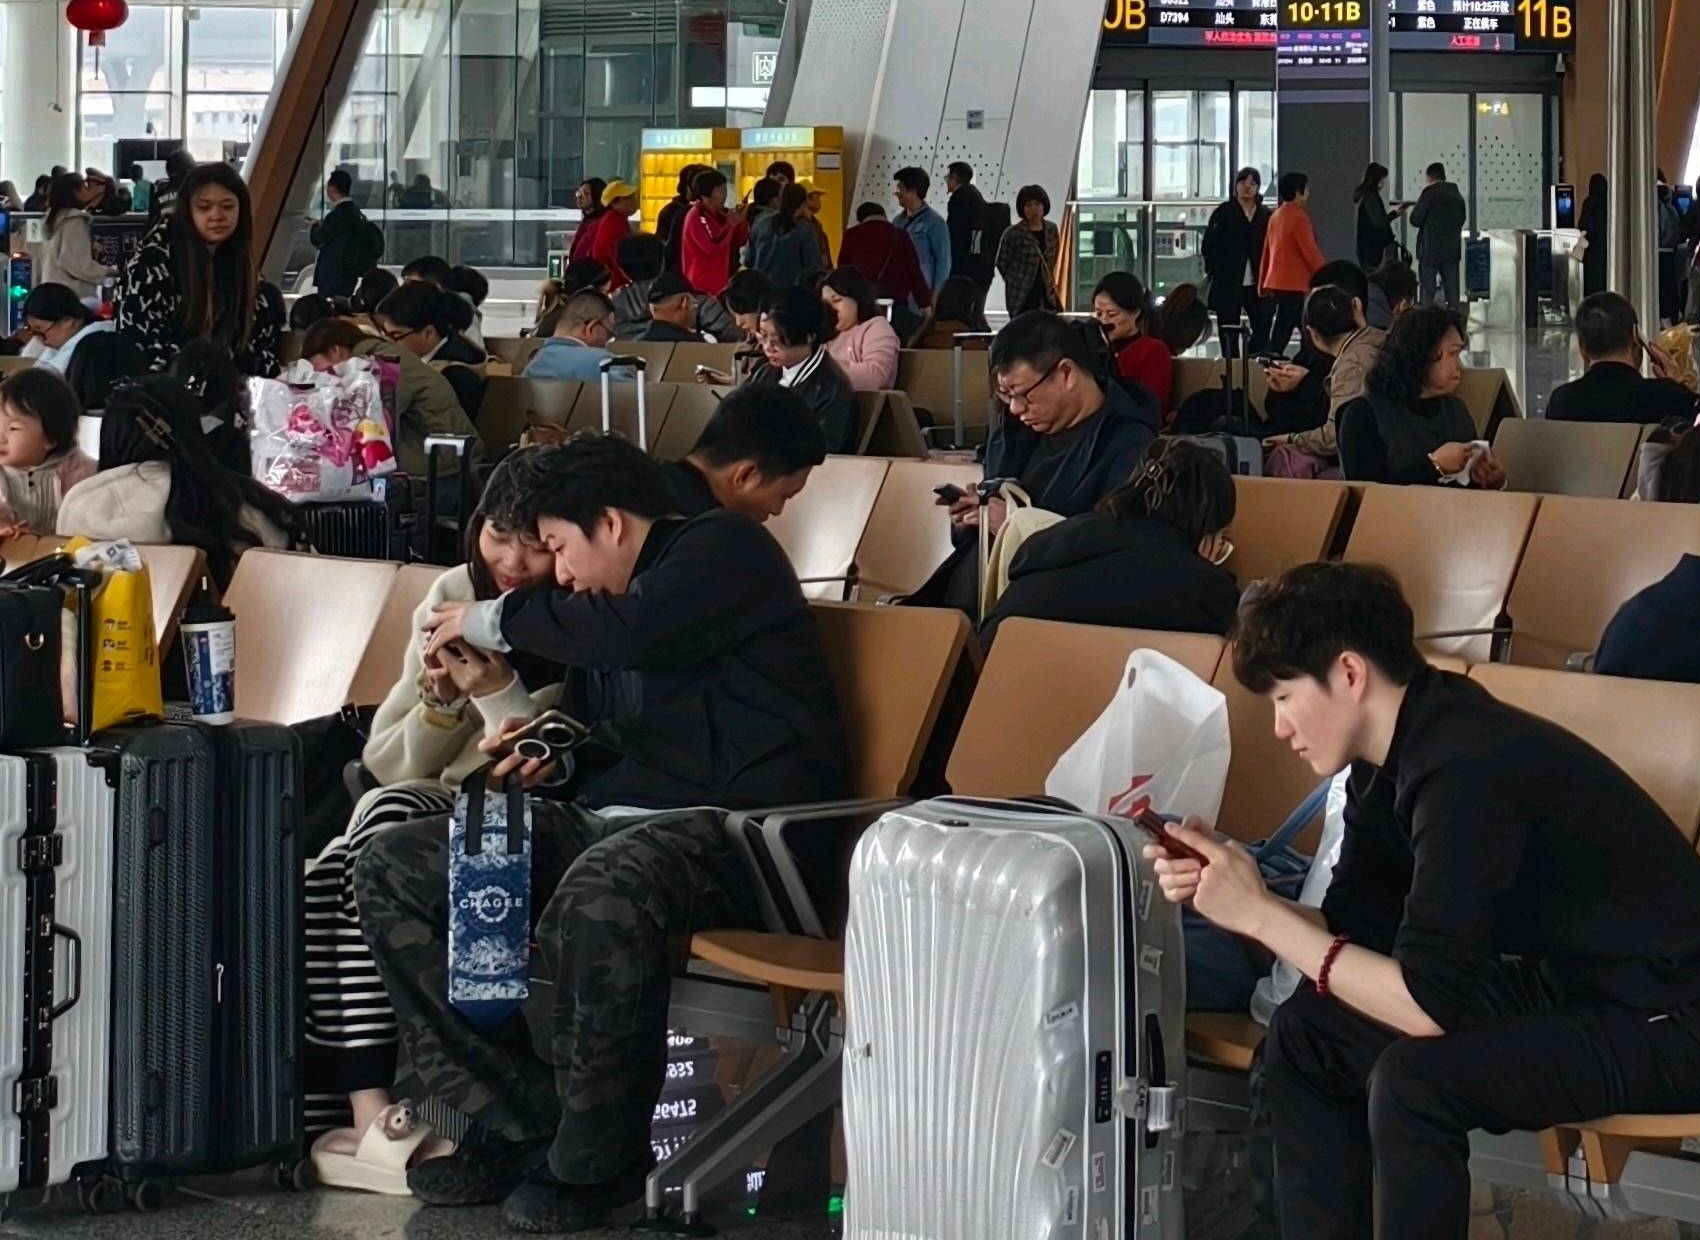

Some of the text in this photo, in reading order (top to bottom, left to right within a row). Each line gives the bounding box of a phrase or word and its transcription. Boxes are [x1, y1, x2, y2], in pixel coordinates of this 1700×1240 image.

[1160, 10, 1189, 24] D7394
[1215, 11, 1235, 25] 汕头
[459, 897, 523, 909] CHAGEE
